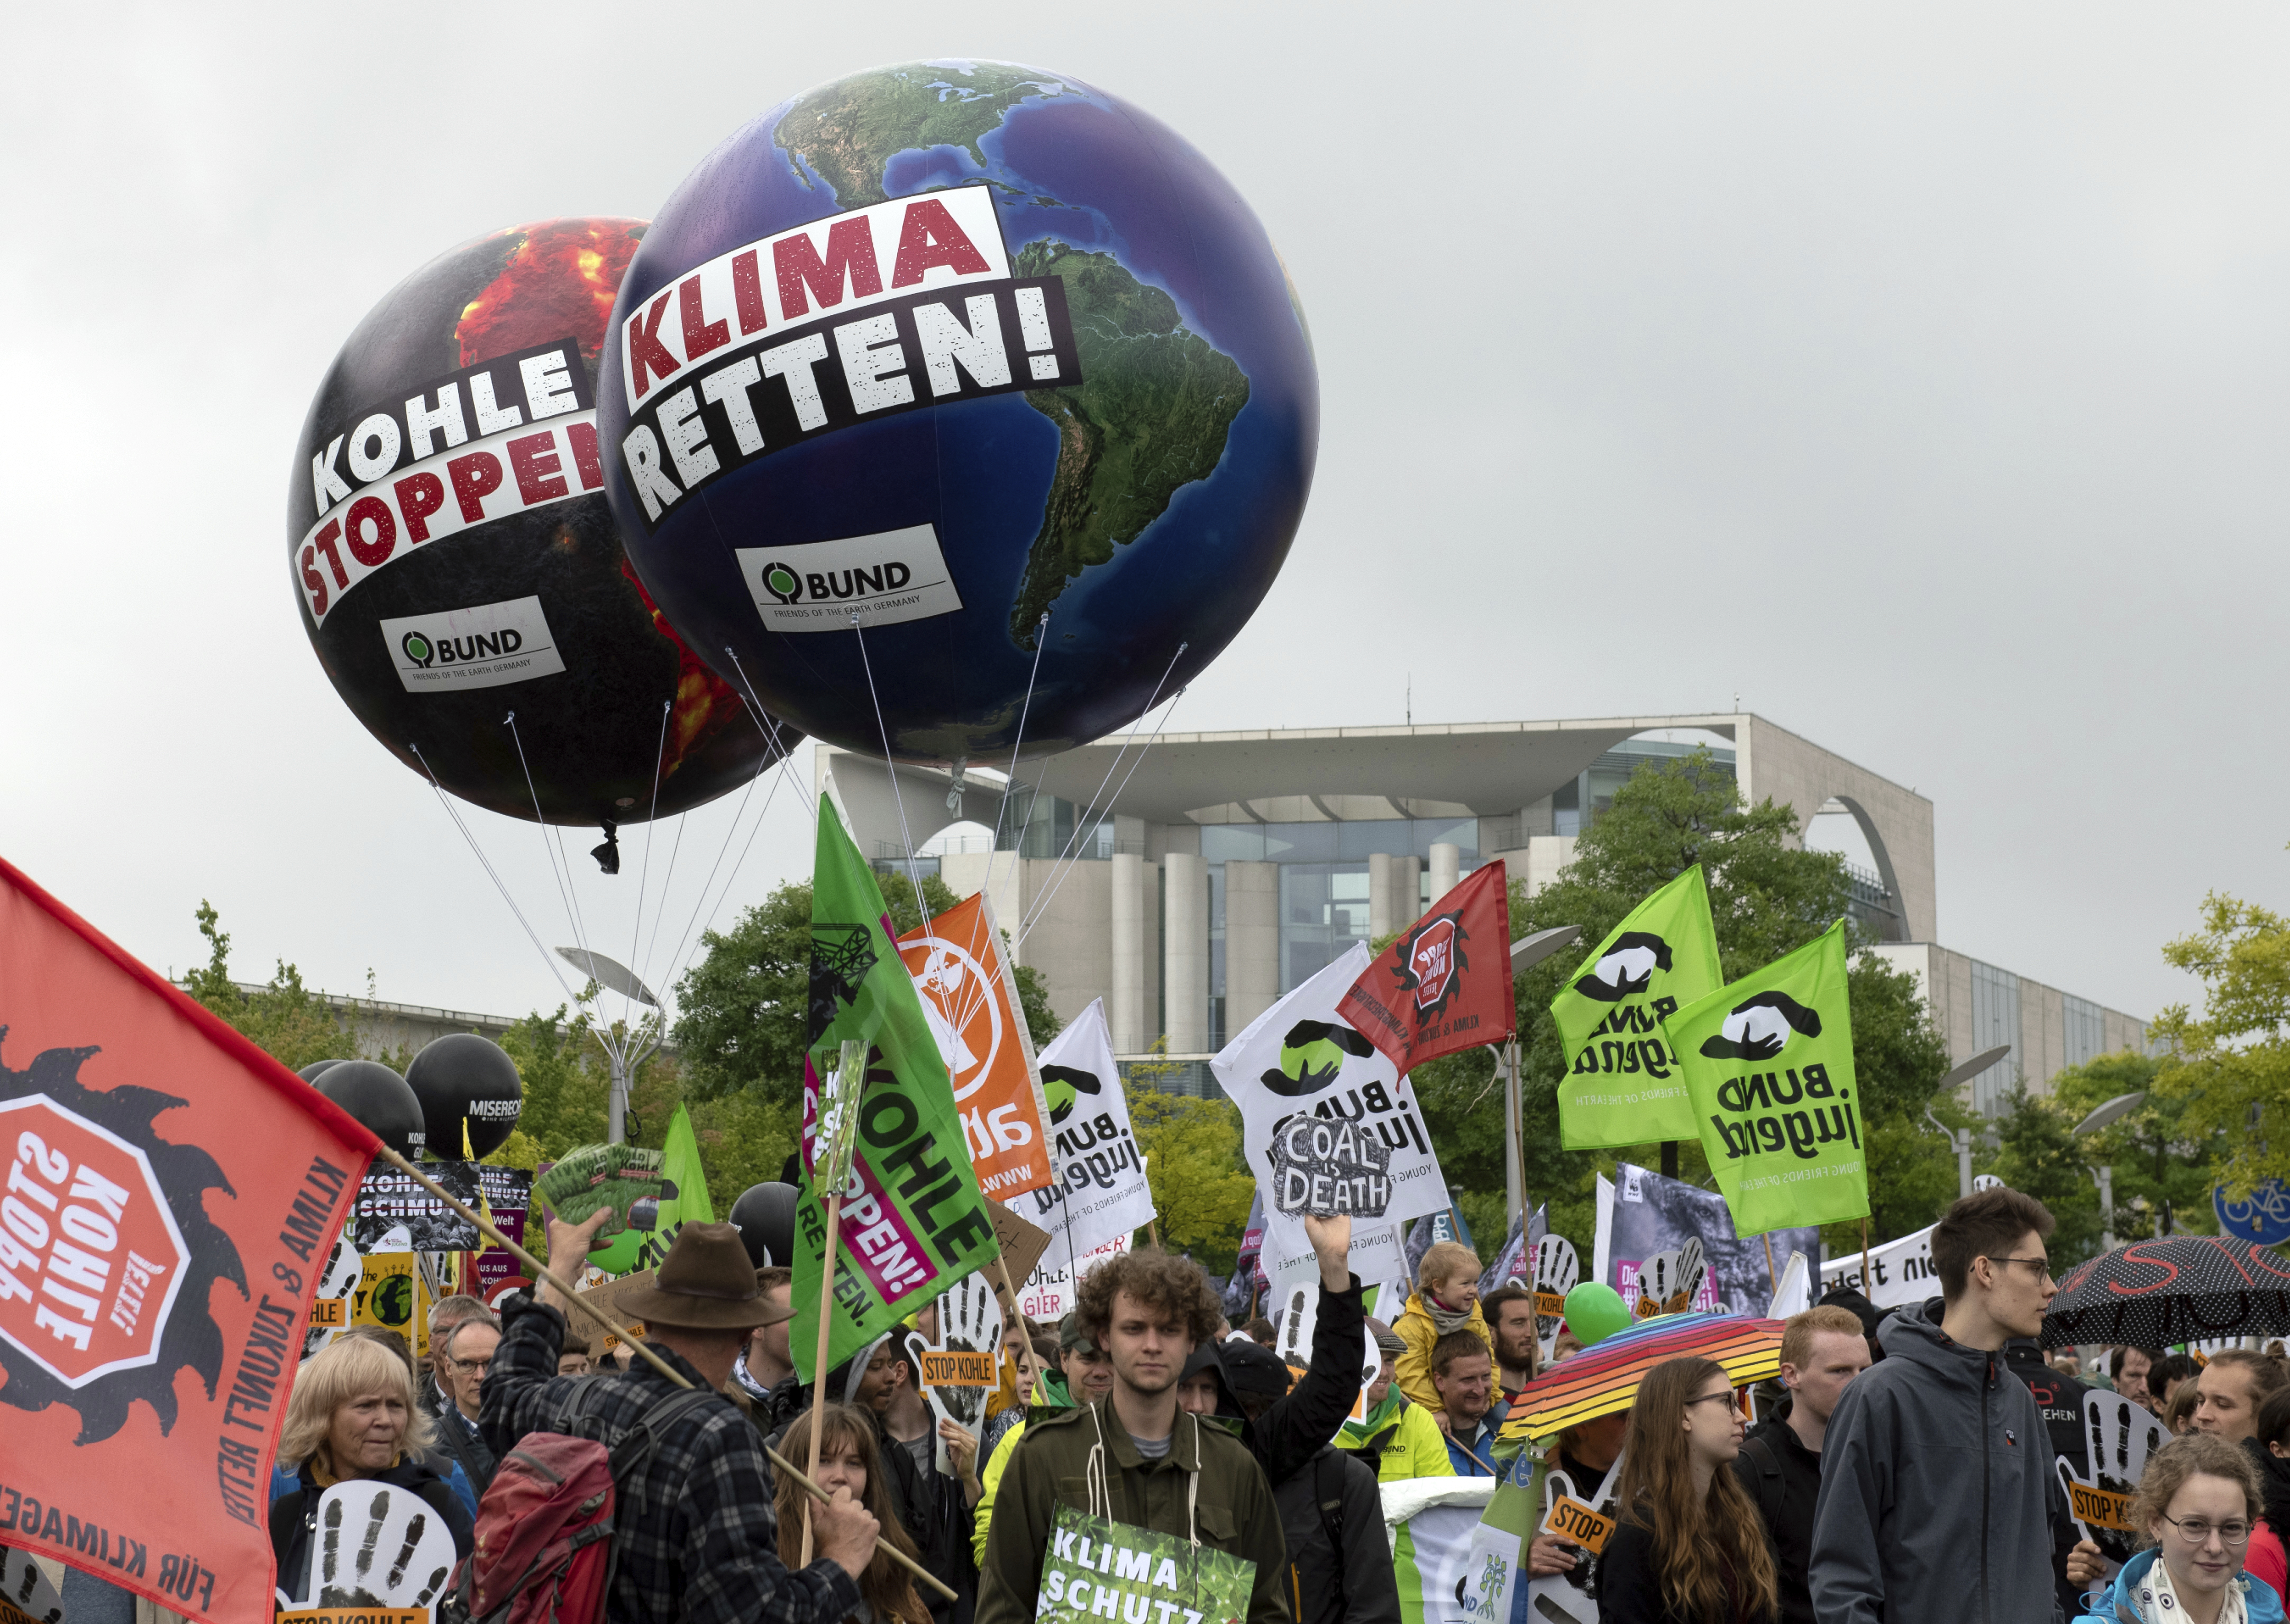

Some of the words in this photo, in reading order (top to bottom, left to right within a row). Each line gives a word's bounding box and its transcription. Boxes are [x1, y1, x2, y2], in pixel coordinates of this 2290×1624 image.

[628, 198, 992, 400] KLIMA
[622, 286, 1060, 523] RETTEN!
[312, 350, 579, 517] KOHLE
[806, 562, 911, 600] BUND
[774, 609, 809, 618] FRIENDS
[812, 608, 823, 617] OF
[844, 604, 871, 615] EARTH
[874, 595, 921, 610] GERMANY
[436, 629, 523, 663] BUND
[413, 672, 441, 681] FRIENDS
[452, 670, 467, 678] THE
[469, 667, 492, 676] EARTH
[494, 659, 531, 673] GERMANY
[859, 1044, 996, 1266] KOHLE
[1285, 1121, 1380, 1170] COAL
[1325, 1162, 1340, 1176] IS
[482, 1187, 528, 1200] HMUTZ
[1283, 1166, 1386, 1209] DEATH
[493, 1215, 514, 1225] Welt
[311, 1303, 337, 1322] HLE
[1024, 1294, 1060, 1317] GIER
[926, 1357, 956, 1380] STOP
[957, 1357, 991, 1381] KOHLE
[2075, 1489, 2111, 1521] STOP
[1554, 1503, 1604, 1543] STOP
[1053, 1526, 1178, 1591] KLIMA
